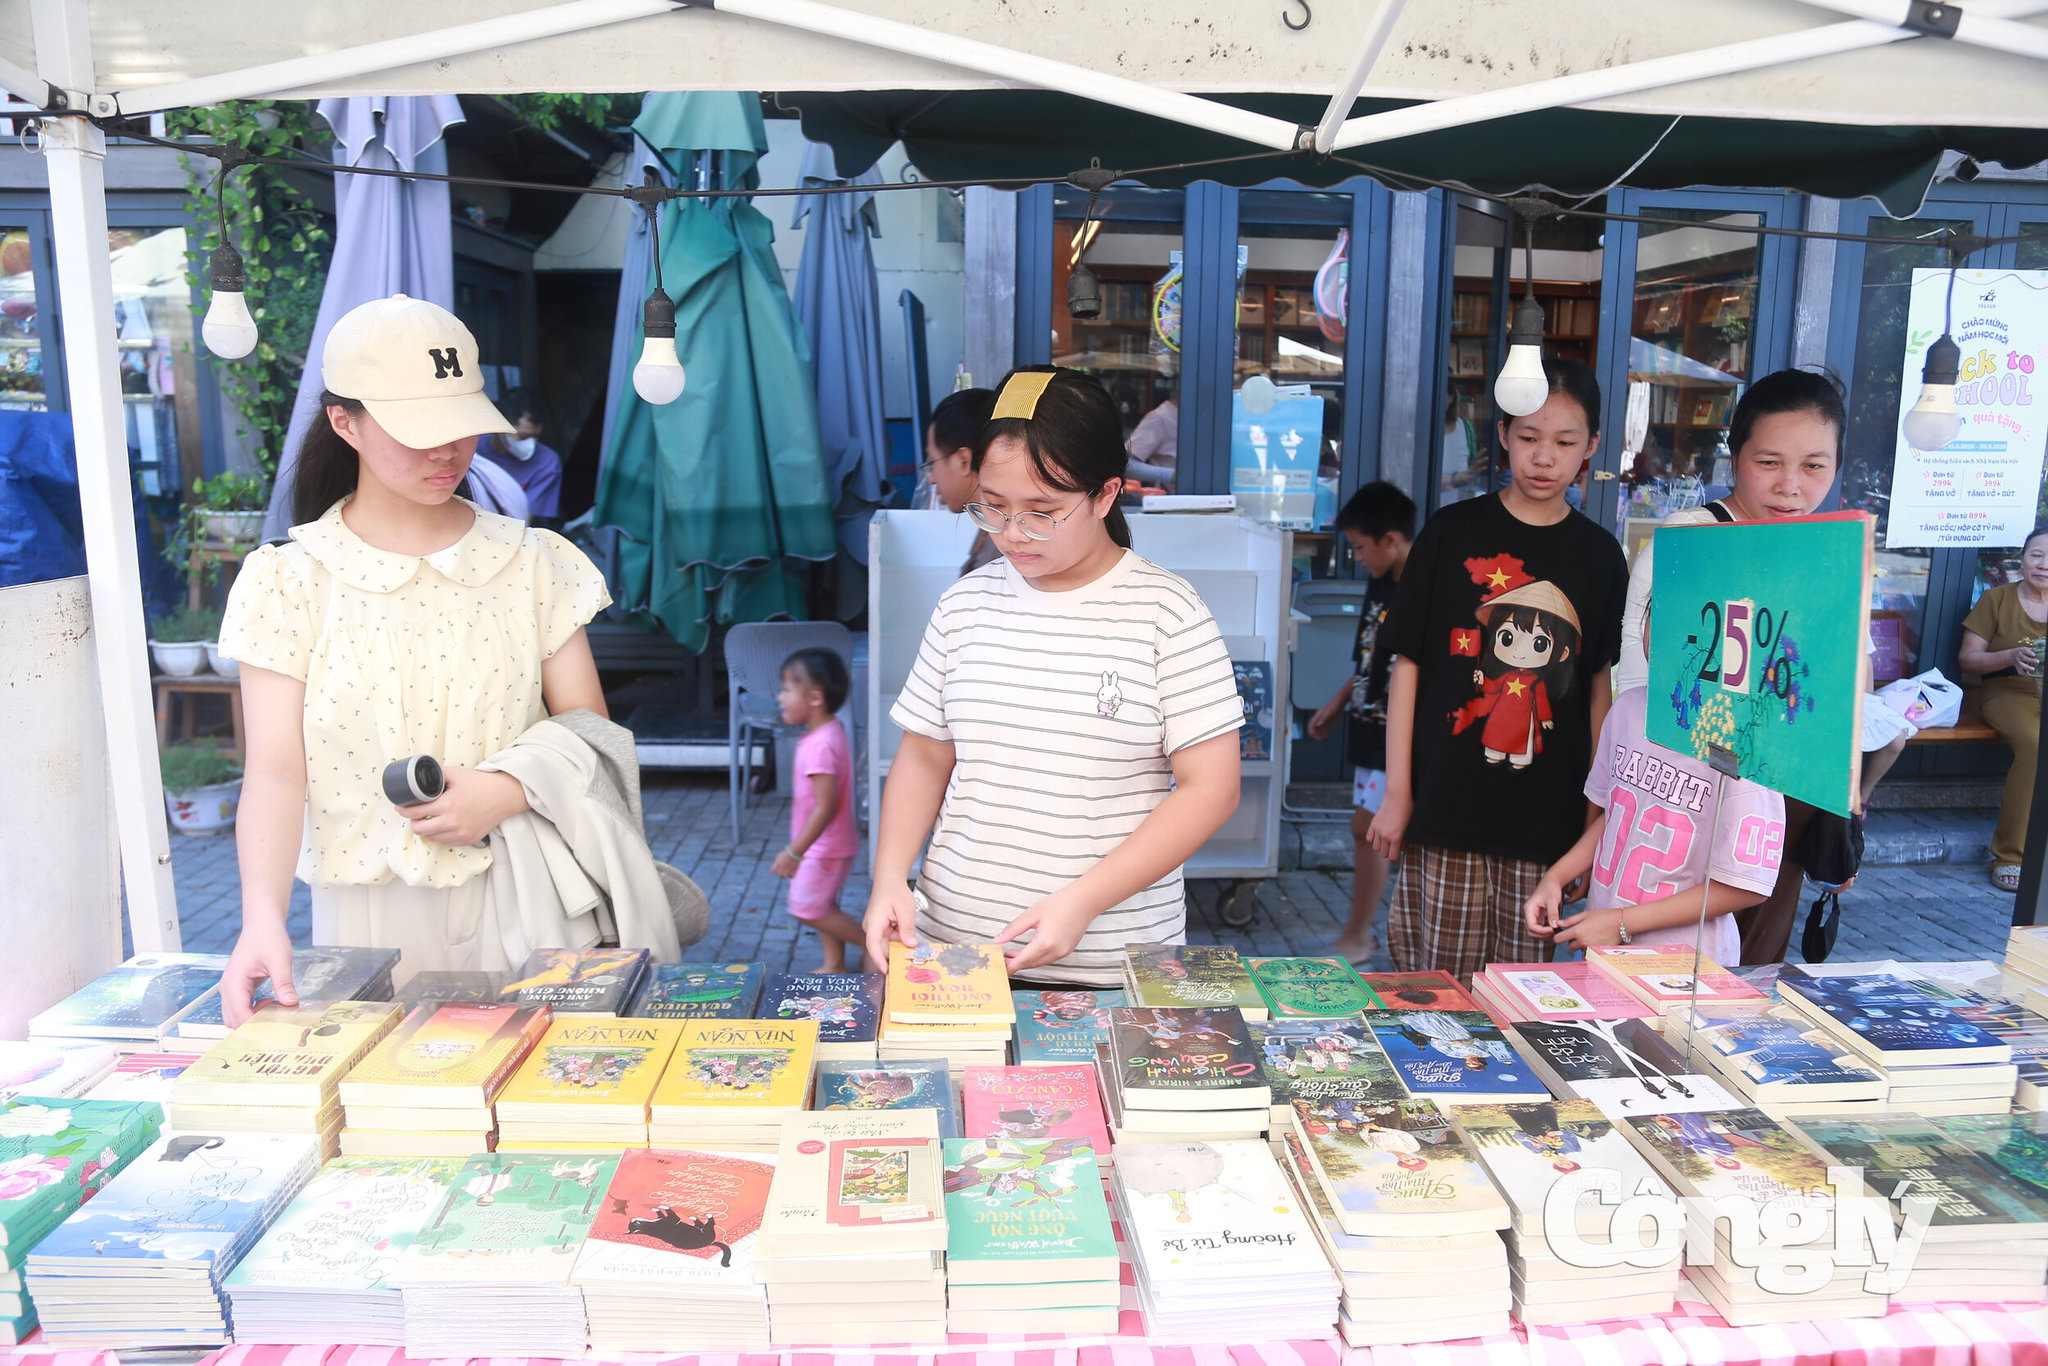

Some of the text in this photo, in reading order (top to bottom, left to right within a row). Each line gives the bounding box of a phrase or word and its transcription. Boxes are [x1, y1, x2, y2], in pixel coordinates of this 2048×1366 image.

[1961, 316, 2009, 332] CHÀO MỪNG
[1957, 331, 2009, 345] NĂM HỌC MỚI
[429, 347, 464, 379] M
[1956, 349, 2035, 384] ck to
[1954, 373, 2033, 405] HOOL
[1973, 411, 2022, 434] quà tặng
[1611, 744, 1712, 813] RABBIT
[1593, 784, 1697, 905] 02
[1732, 813, 1785, 870] 02
[518, 986, 608, 995] KHÔNG GIAN
[1555, 1053, 1613, 1068] bạch
[1148, 1078, 1242, 1087] ANDREA HIRATA
[1393, 1174, 1457, 1200] Anne
[990, 1222, 1066, 1239] ÔNG NỘI
[1160, 1229, 1296, 1252] Hoàng Tử Bé
[1041, 1236, 1084, 1249] David
